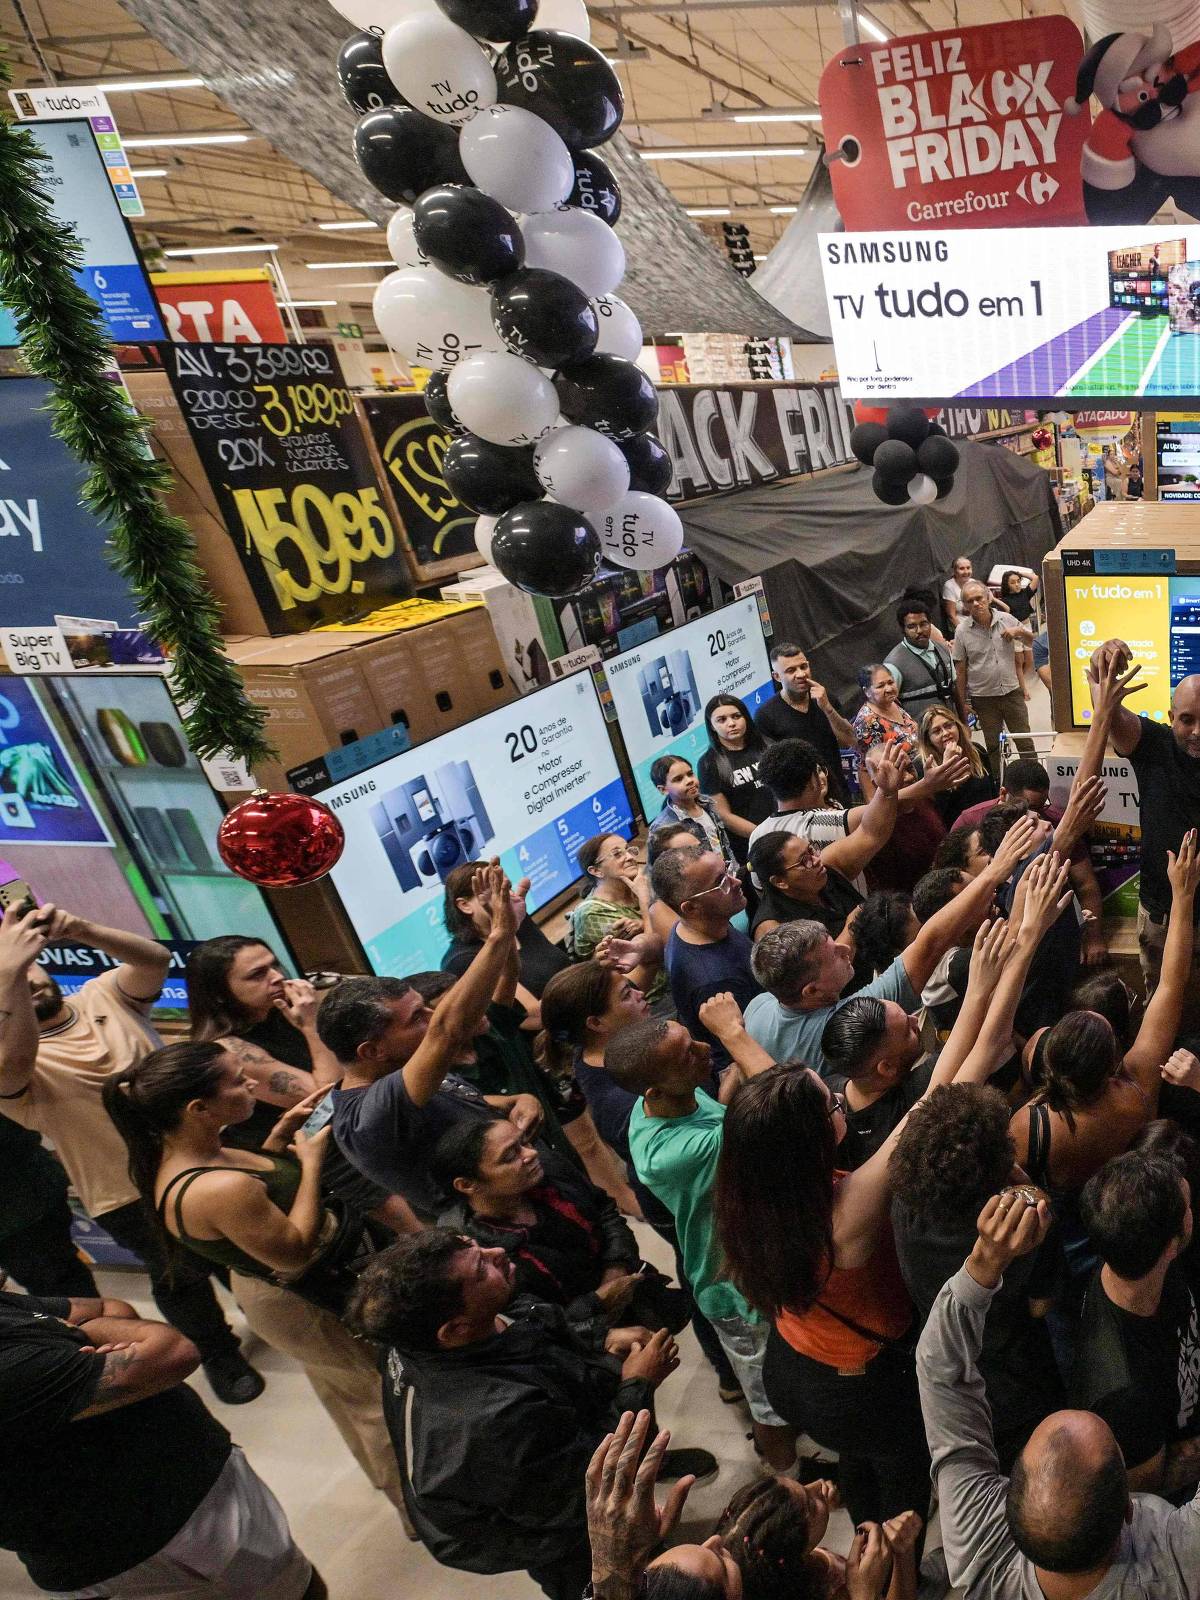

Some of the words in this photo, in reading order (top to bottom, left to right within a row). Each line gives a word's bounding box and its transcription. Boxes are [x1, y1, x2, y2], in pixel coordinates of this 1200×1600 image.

[537, 44, 554, 67] TV
[870, 37, 966, 85] FELIZ
[431, 80, 452, 97] TV
[47, 95, 81, 111] tudo
[427, 89, 479, 116] tudo
[886, 113, 1063, 189] FRIDAY
[576, 168, 600, 210] tud
[906, 190, 1010, 222] Carrefour
[827, 240, 949, 265] SAMSUNG
[94, 271, 107, 289] 6
[833, 295, 864, 319] TV
[874, 281, 969, 319] tudo
[978, 297, 1024, 317] em
[1030, 280, 1043, 316] 1
[509, 326, 529, 345] TV
[416, 343, 431, 361] TV
[1076, 410, 1128, 423] ATACADO
[509, 433, 529, 445] TV
[605, 516, 614, 538] em
[622, 513, 640, 557] tudo
[641, 531, 655, 547] TV
[1074, 589, 1089, 599] TV
[1091, 583, 1133, 599] tudo
[1133, 589, 1154, 599] em
[1155, 584, 1162, 599] 1
[10, 633, 54, 649] Super
[707, 629, 726, 657] 20
[17, 651, 41, 670] Big
[45, 650, 62, 666] TV
[568, 655, 587, 669] tudo
[609, 654, 642, 676] SAMSUNG
[725, 656, 740, 669] Motor
[722, 661, 752, 684] Compressor
[504, 724, 538, 764] 20
[538, 722, 558, 737] Anos
[557, 716, 568, 727] de
[541, 724, 574, 746] Garantia
[537, 754, 563, 775] Motor
[297, 776, 315, 790] UHD
[531, 758, 584, 796] Compressor
[526, 793, 556, 815] Digital
[592, 797, 602, 813] 6
[557, 818, 569, 836] 5
[519, 845, 529, 861] 4
[426, 905, 440, 926] 2
